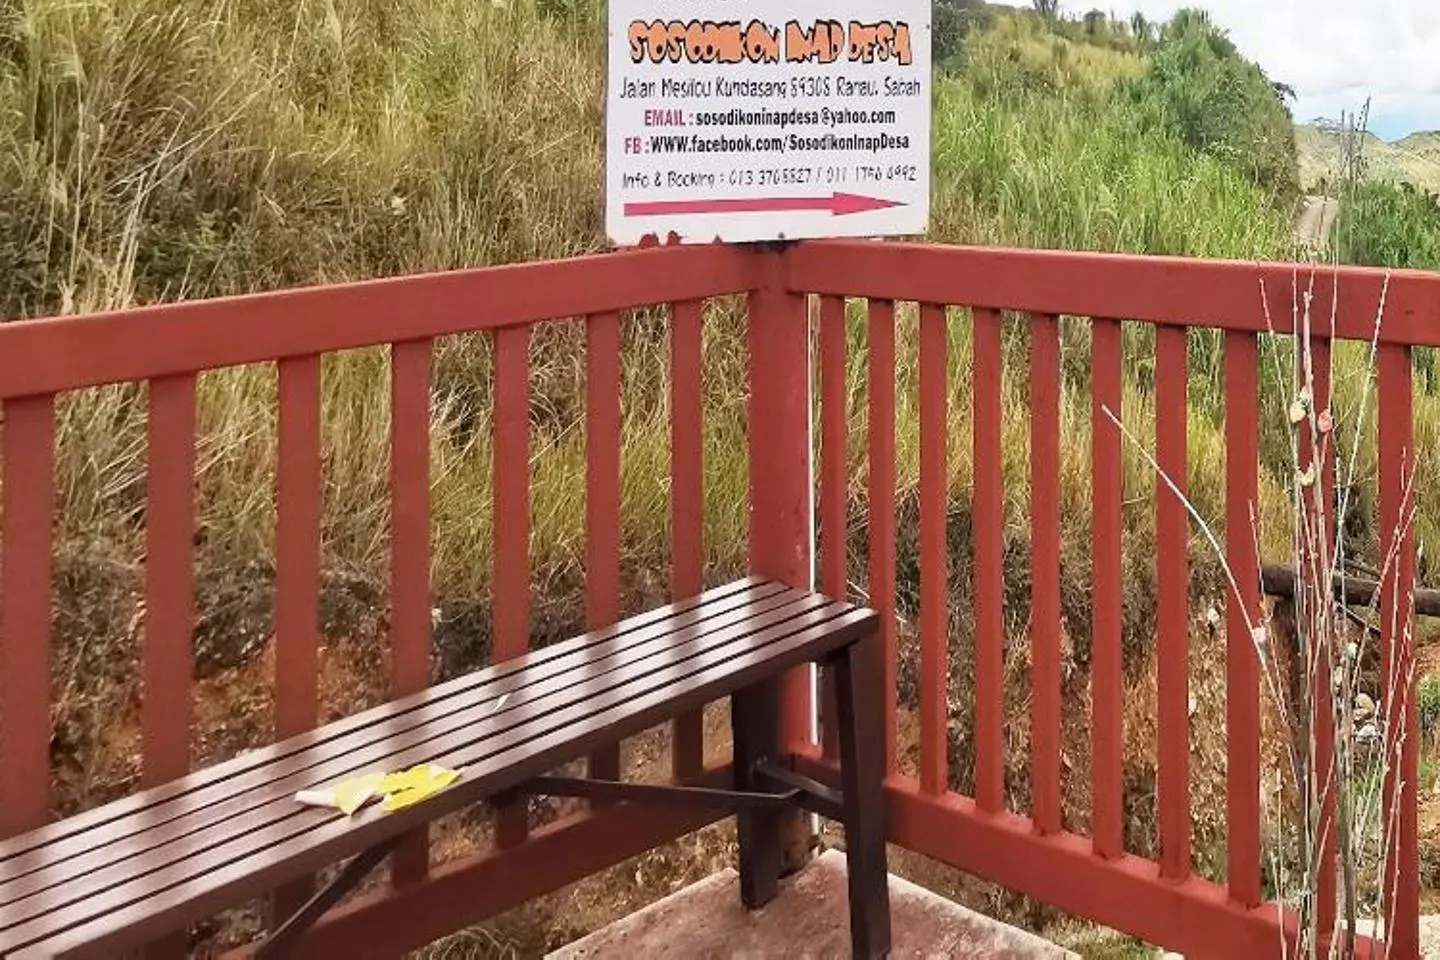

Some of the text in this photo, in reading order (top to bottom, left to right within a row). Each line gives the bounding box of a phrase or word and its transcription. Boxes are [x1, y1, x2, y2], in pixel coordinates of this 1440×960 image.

[620, 76, 656, 98] Jalan
[715, 76, 786, 98] Kundasang
[884, 76, 920, 96] Sabah
